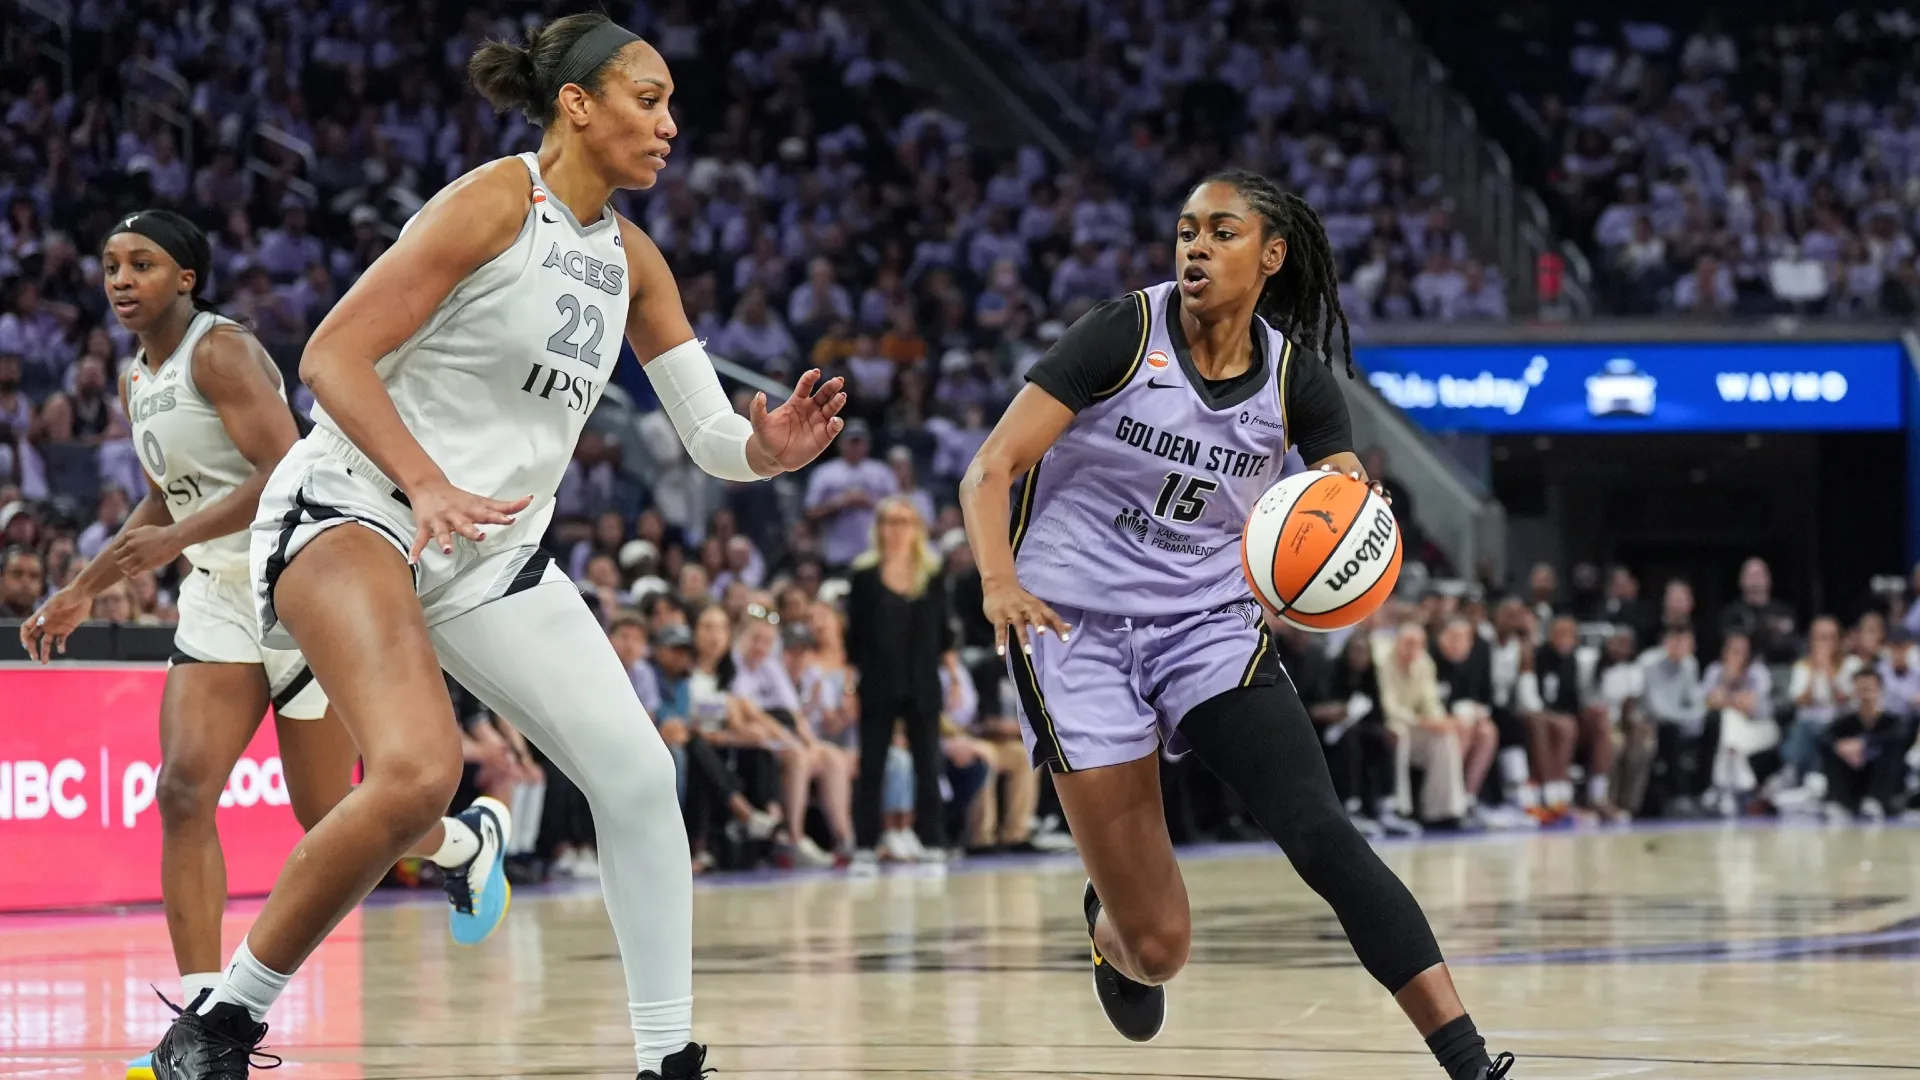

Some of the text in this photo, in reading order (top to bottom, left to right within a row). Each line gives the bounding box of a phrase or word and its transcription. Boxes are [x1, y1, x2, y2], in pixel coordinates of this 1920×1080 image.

[542, 242, 625, 296] ACES
[546, 293, 605, 369] 22
[131, 386, 177, 424] ACES
[521, 363, 599, 415] IPSY
[1716, 371, 1848, 402] WAYMO
[1250, 415, 1283, 430] freedom
[142, 430, 166, 476] 0
[1115, 415, 1271, 478] GOLDEN STATE
[163, 472, 202, 506] SY
[1152, 470, 1219, 524] 15
[1151, 537, 1216, 556] PERMANENT
[1156, 527, 1190, 542] KAISER
[1324, 508, 1393, 592] Wilson
